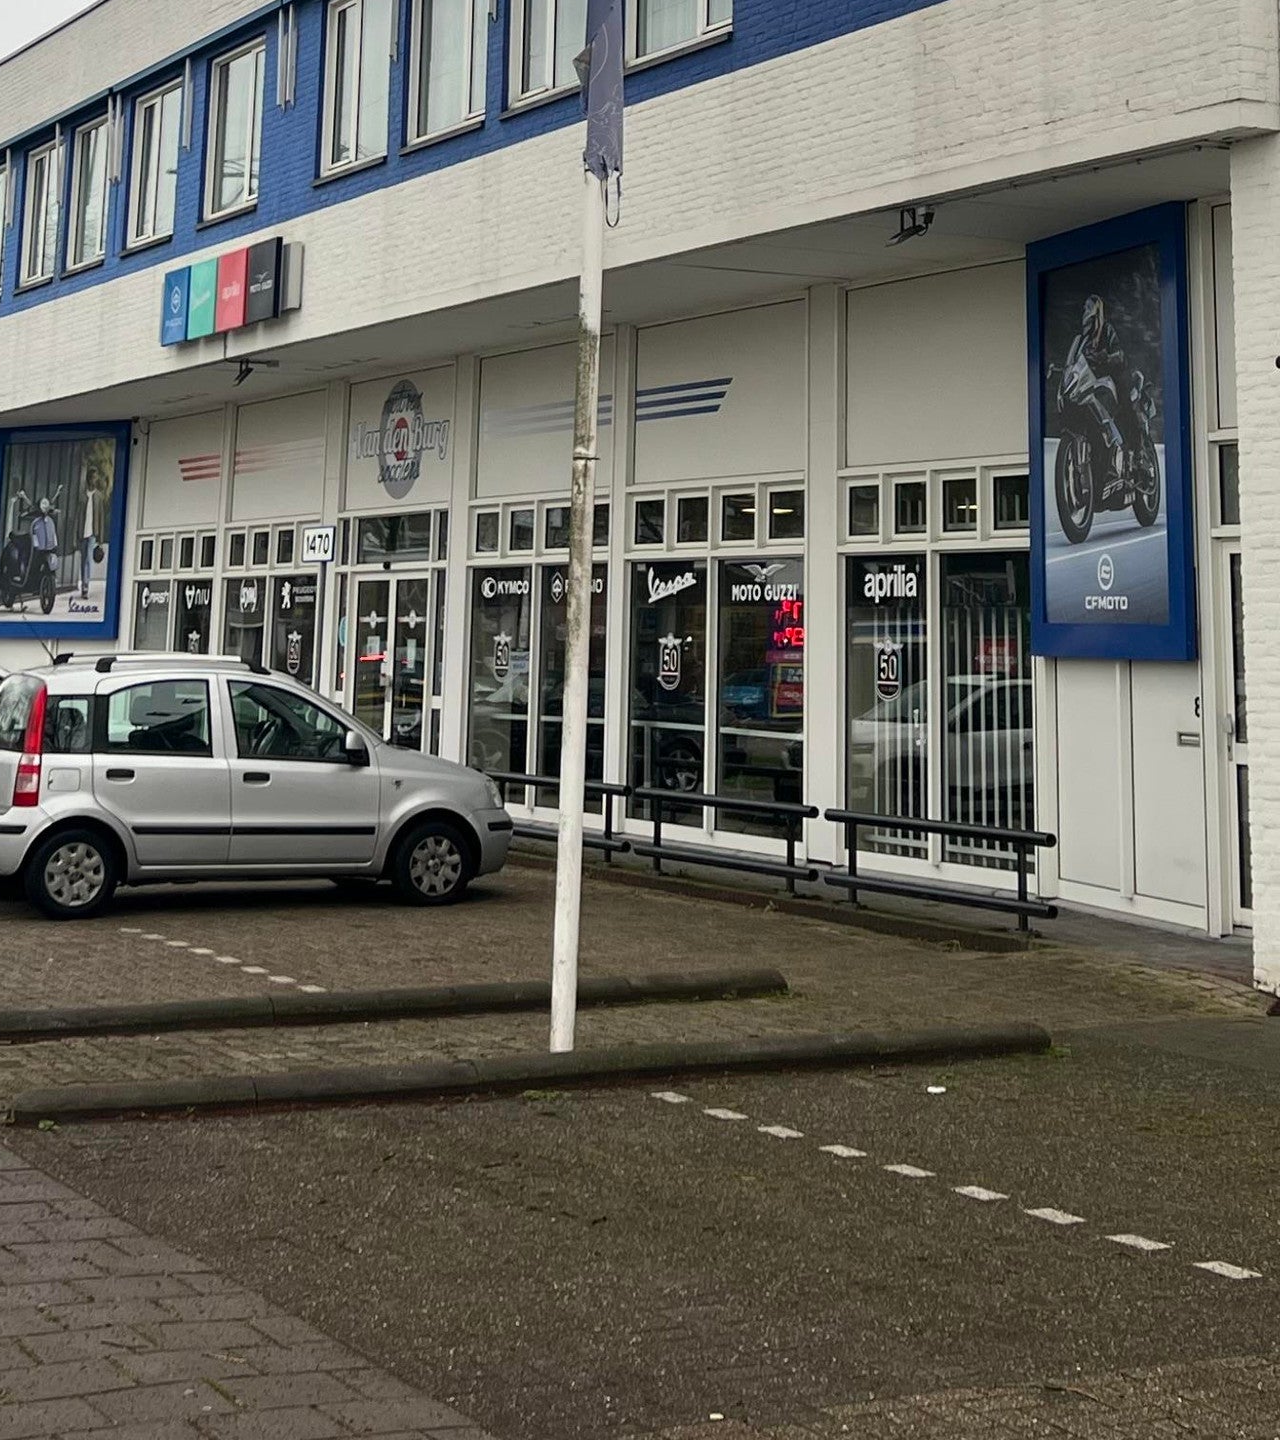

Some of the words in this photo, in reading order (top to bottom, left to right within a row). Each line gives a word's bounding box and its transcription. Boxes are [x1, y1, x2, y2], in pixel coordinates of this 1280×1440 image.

[306, 533, 330, 555] 1470
[497, 580, 530, 595] KYMCO
[647, 566, 697, 604] Vespa
[731, 584, 761, 602] MOTO
[764, 584, 797, 602] GUZZI
[864, 564, 917, 604] aprilia
[1085, 596, 1129, 610] CFMOTO
[663, 649, 677, 671] 50
[880, 655, 897, 680] 50
